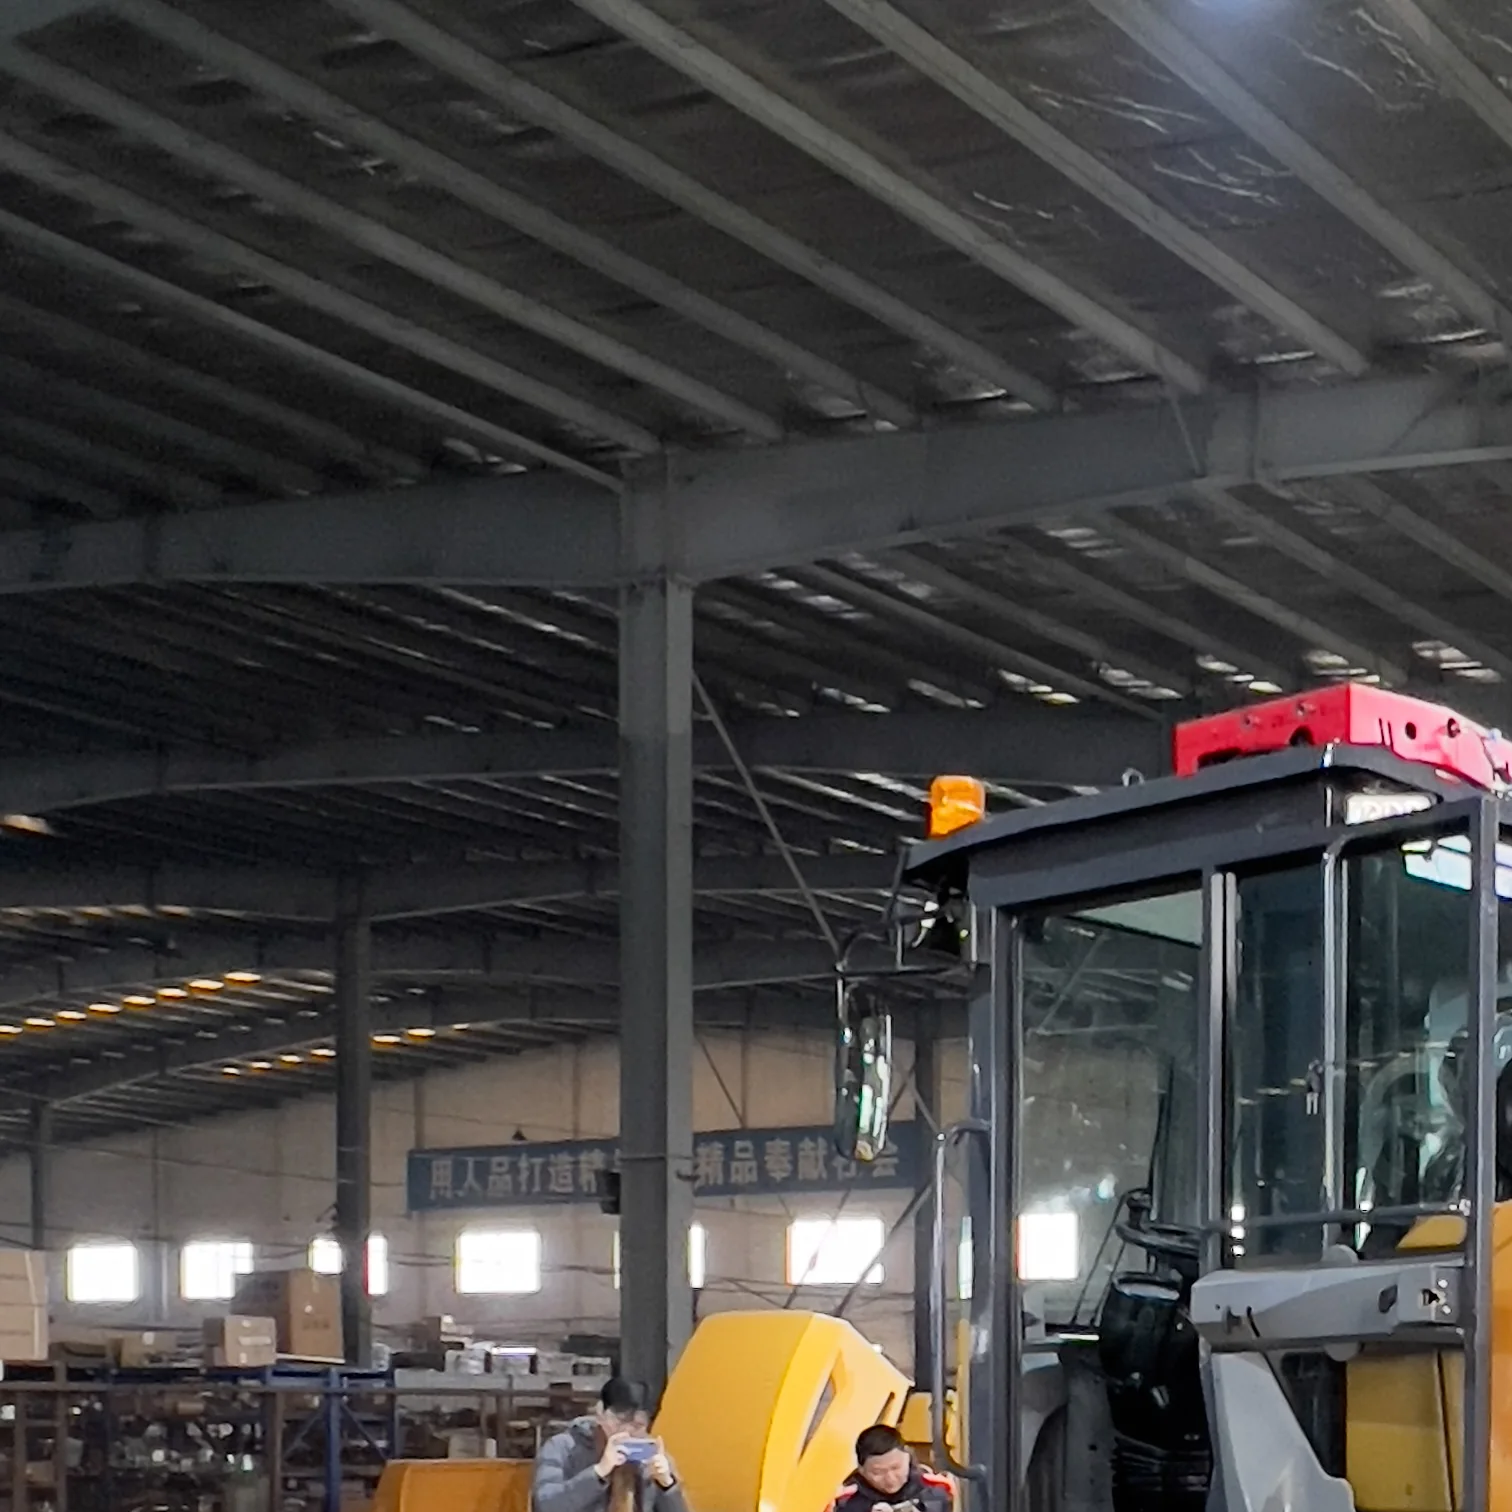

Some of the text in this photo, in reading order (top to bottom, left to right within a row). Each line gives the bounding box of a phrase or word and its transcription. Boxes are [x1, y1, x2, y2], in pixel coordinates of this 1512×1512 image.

[429, 1148, 620, 1200] 用人品打造精
